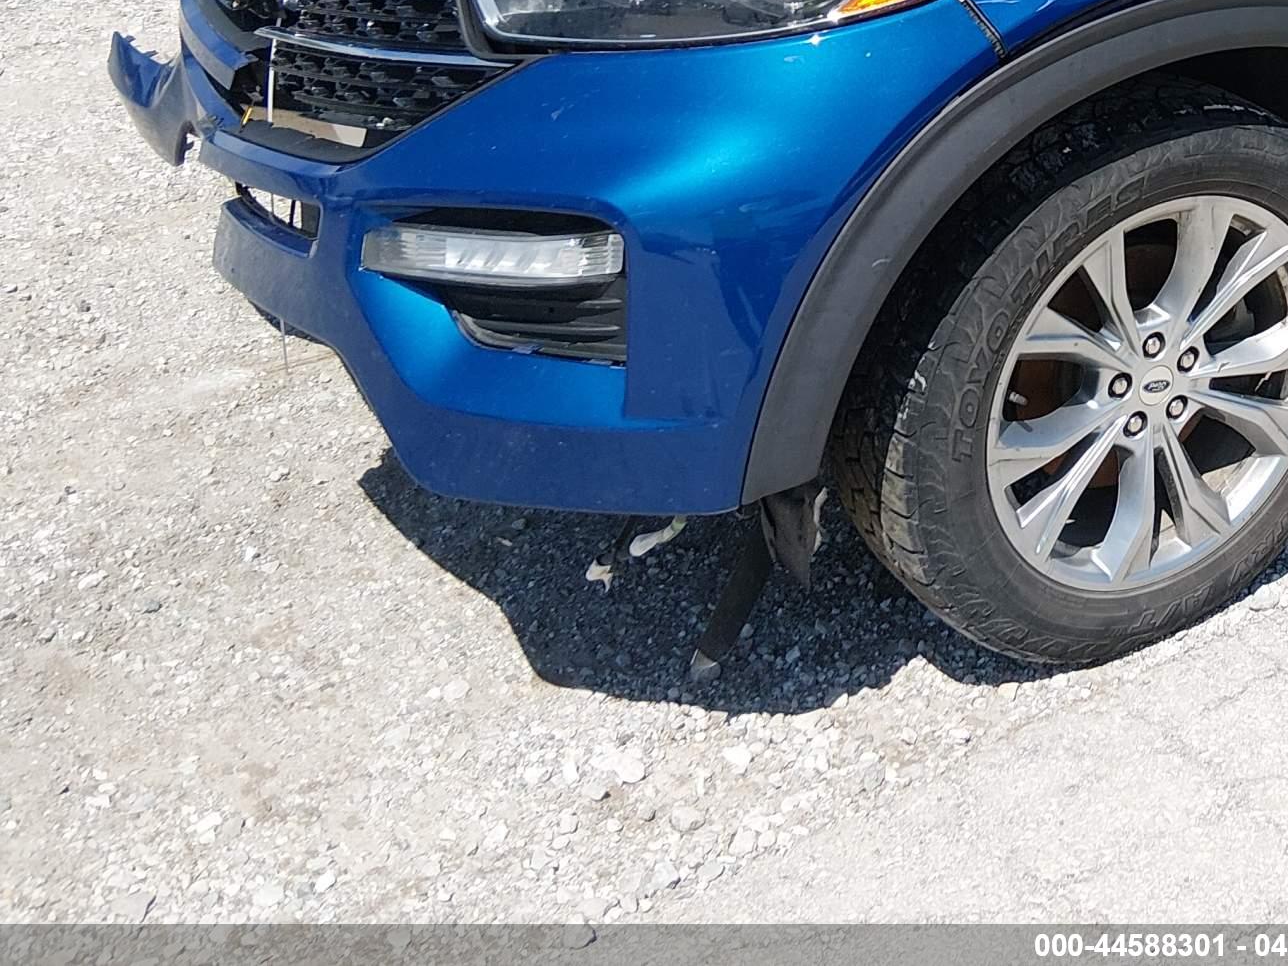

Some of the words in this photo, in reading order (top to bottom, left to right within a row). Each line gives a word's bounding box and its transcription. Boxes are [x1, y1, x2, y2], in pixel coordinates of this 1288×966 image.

[952, 310, 1010, 465] TOYO
[1009, 174, 1146, 303] TIRES
[1129, 581, 1214, 634] A/T
